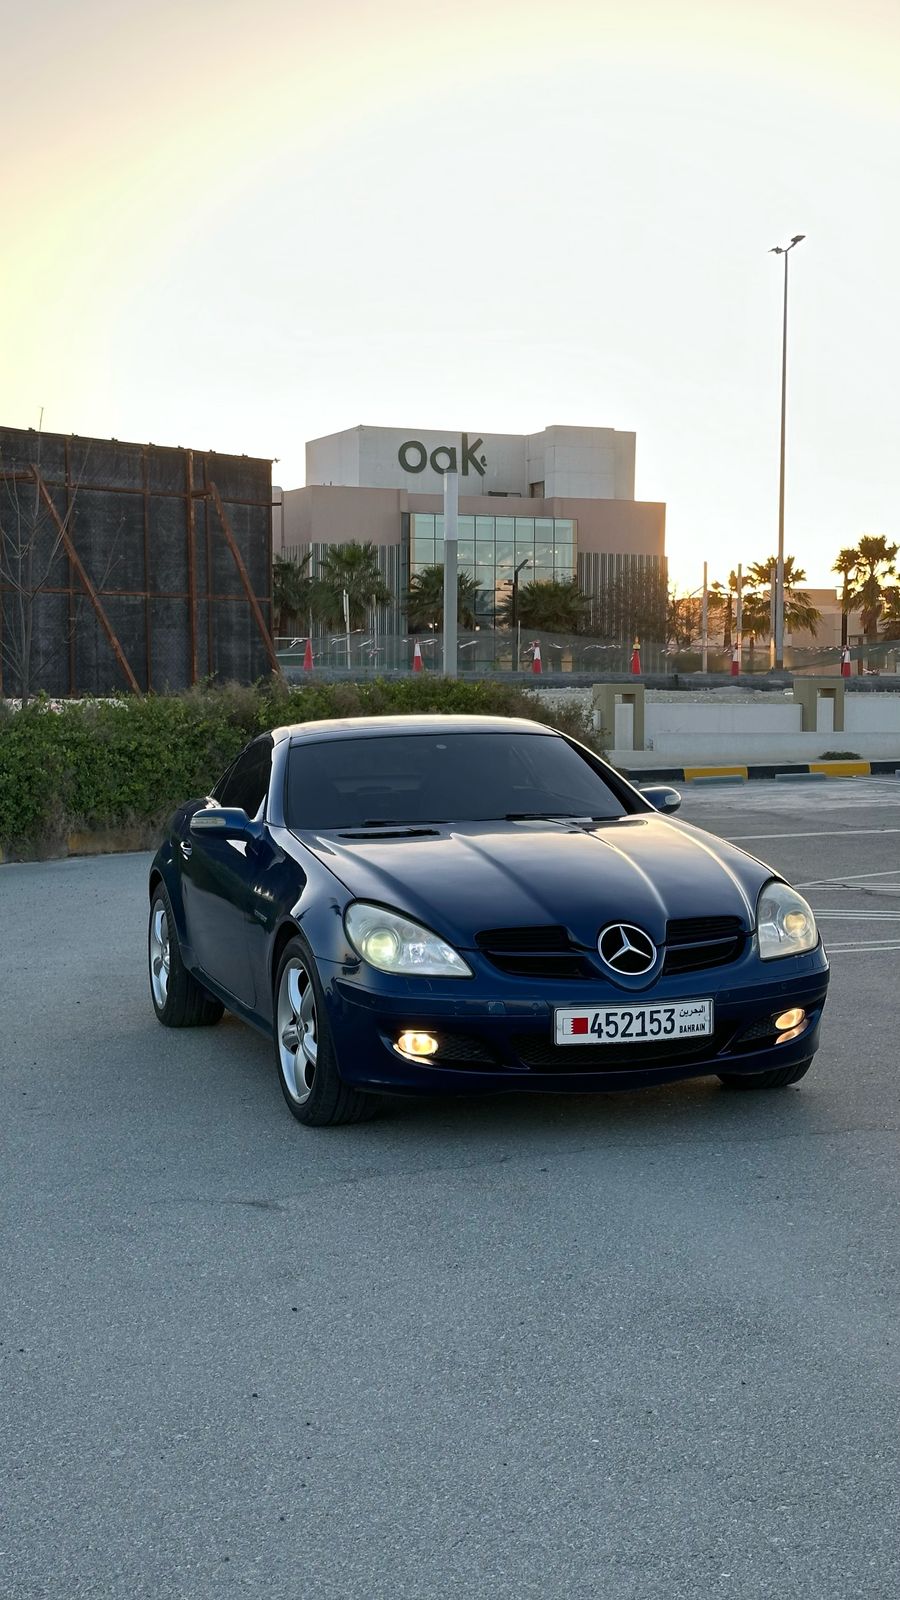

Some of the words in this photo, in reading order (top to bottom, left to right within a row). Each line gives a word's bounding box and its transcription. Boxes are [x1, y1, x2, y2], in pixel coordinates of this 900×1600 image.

[679, 1005, 706, 1017] البحرين
[590, 1008, 676, 1039] 452153
[679, 1023, 706, 1034] BAHRAIN
